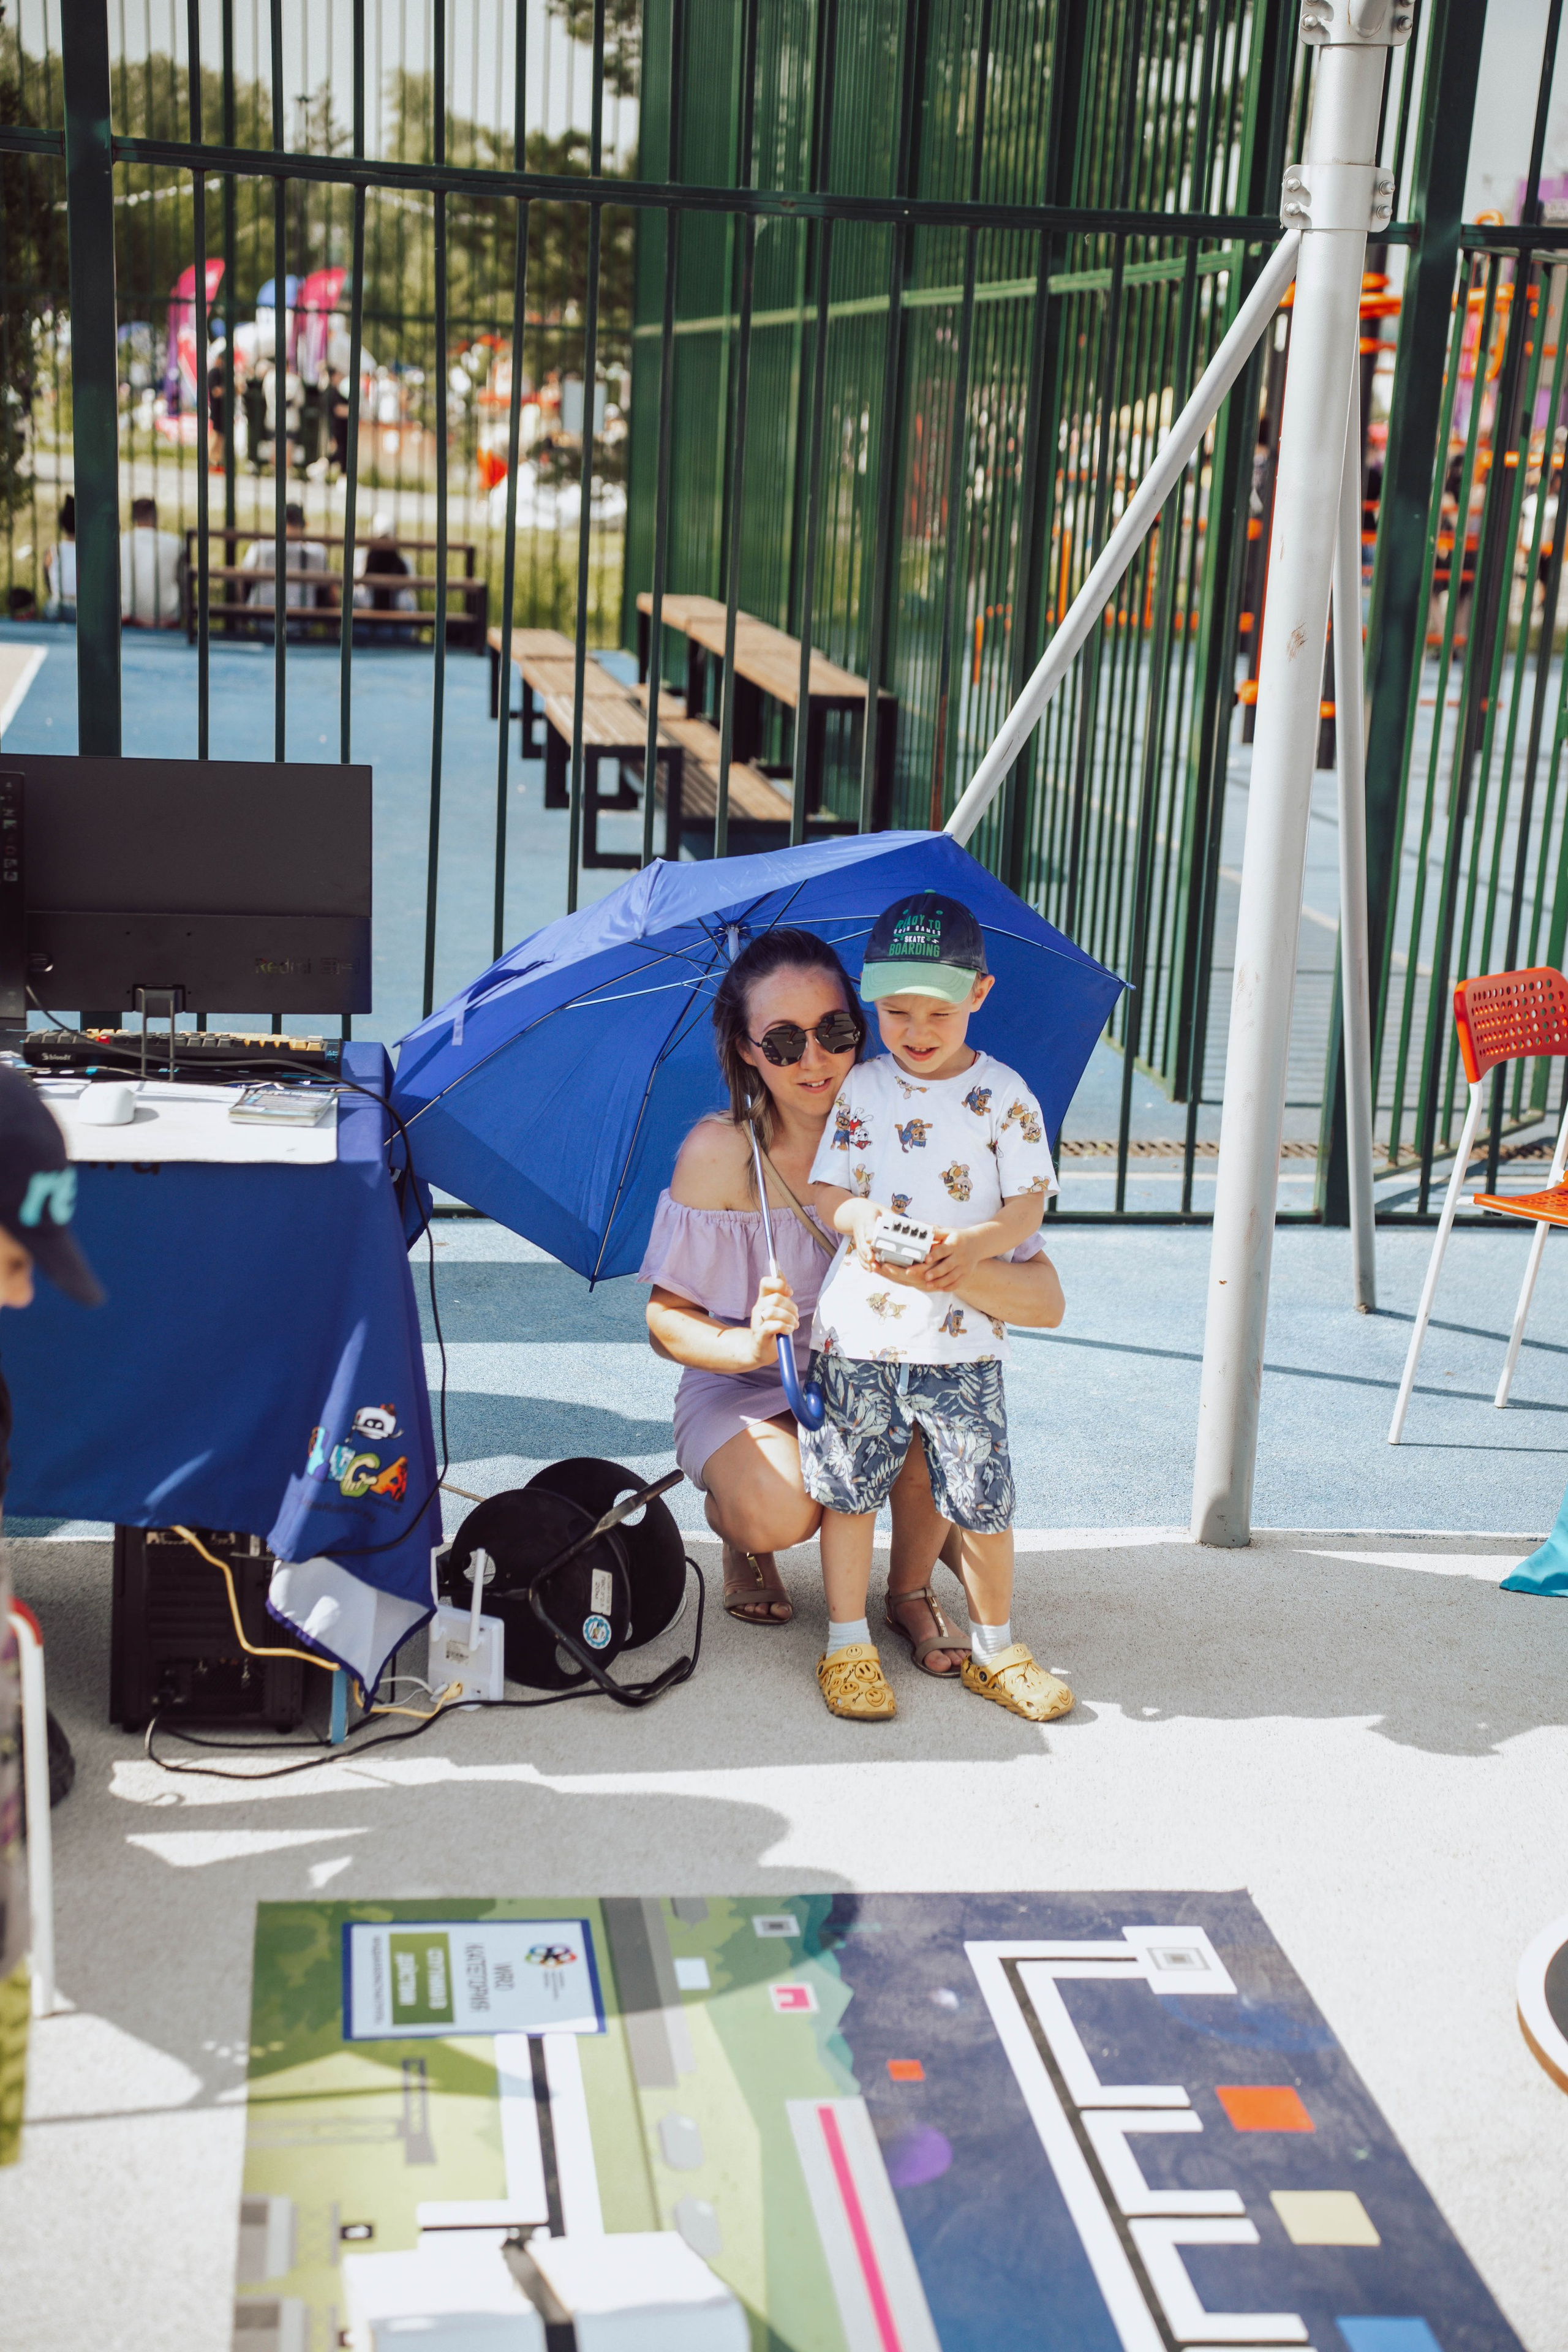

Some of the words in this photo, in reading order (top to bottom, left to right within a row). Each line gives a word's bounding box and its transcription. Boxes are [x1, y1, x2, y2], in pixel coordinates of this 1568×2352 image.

[895, 914, 925, 929] READY
[929, 919, 941, 930] TO
[915, 925, 941, 936] GAMES
[889, 943, 940, 957] BOARDING
[255, 957, 311, 974] Redmi
[464, 1942, 491, 2013] КАТЕГОРИЯ
